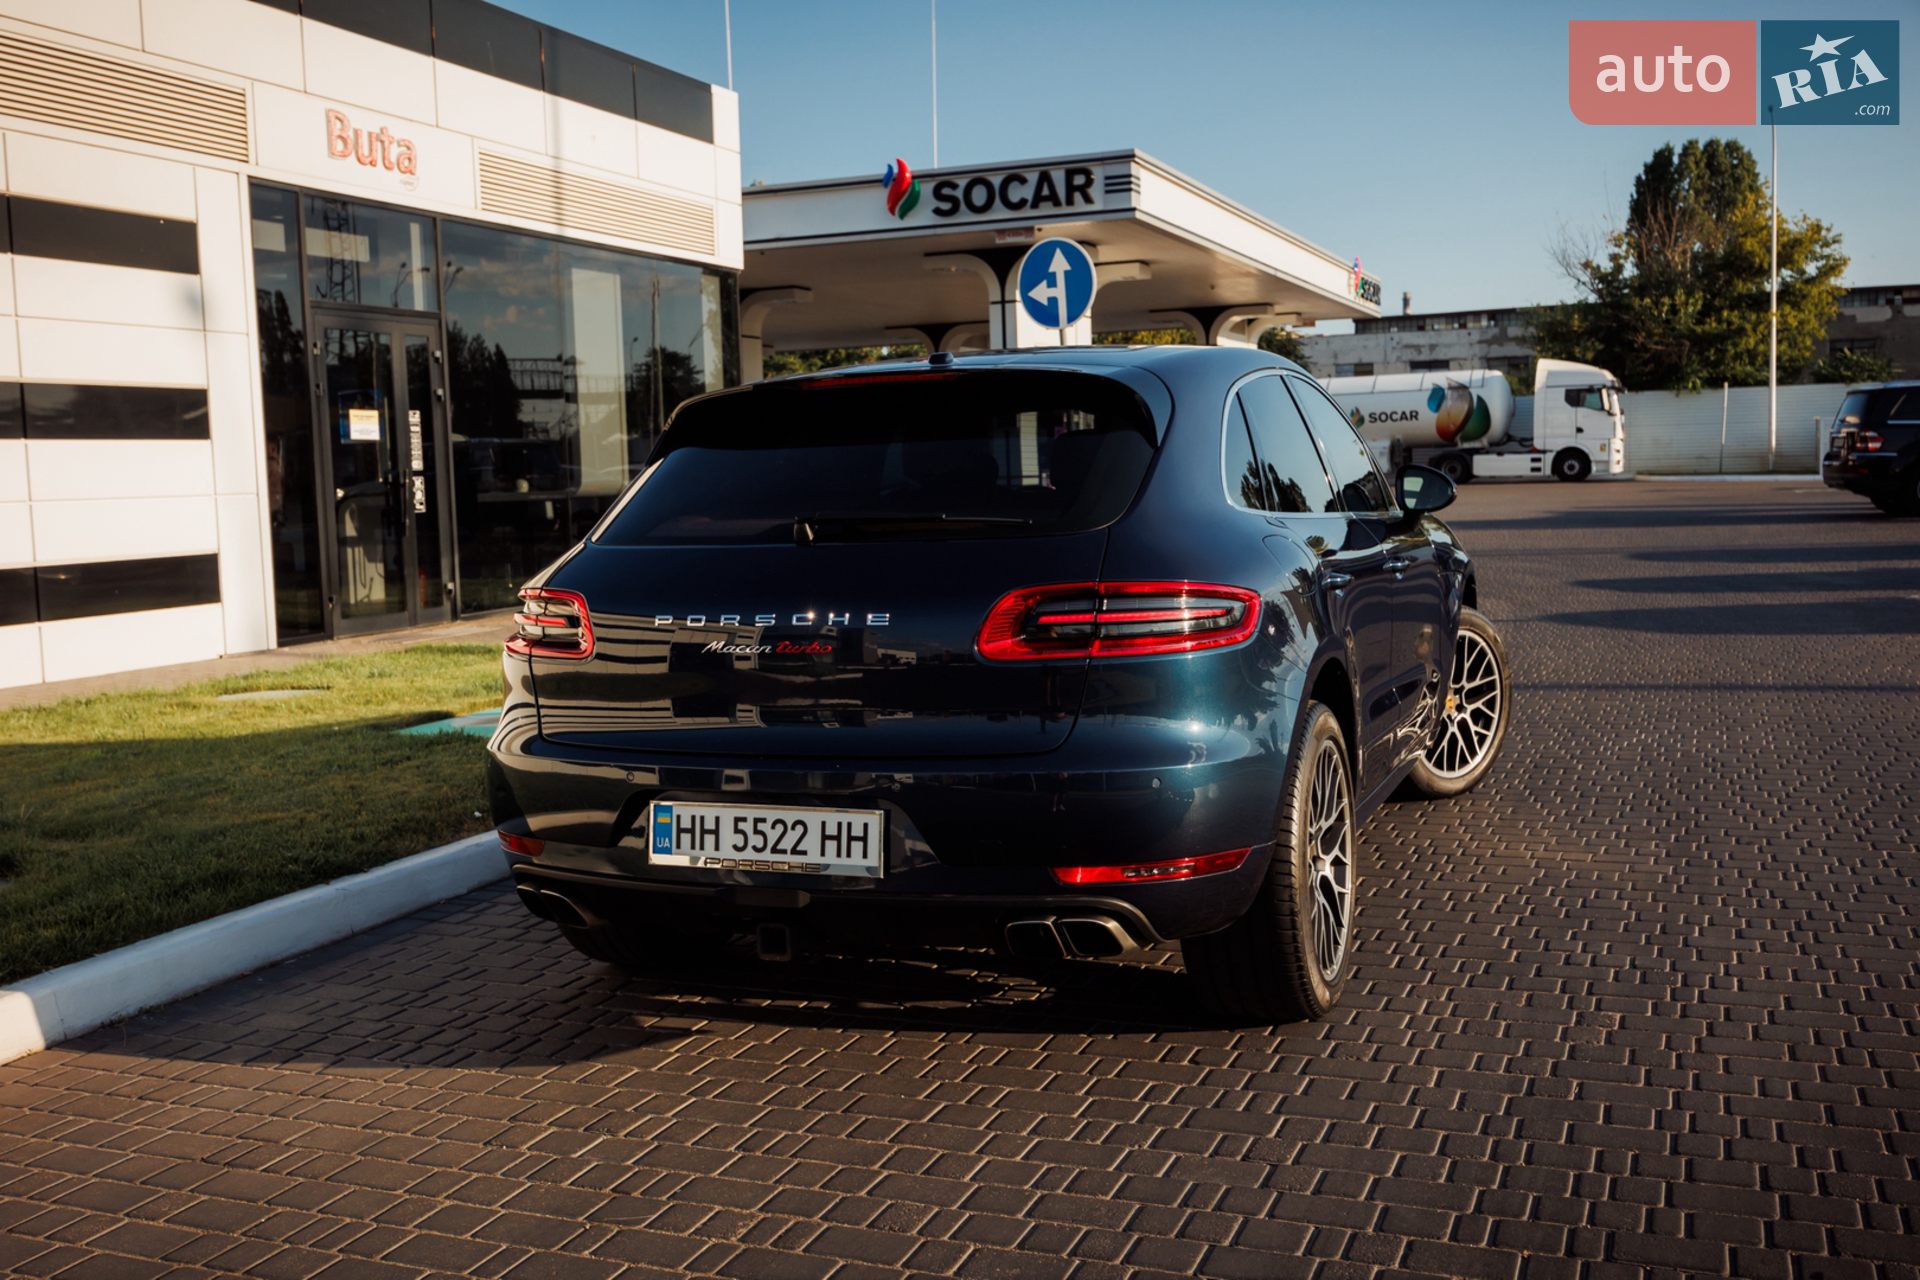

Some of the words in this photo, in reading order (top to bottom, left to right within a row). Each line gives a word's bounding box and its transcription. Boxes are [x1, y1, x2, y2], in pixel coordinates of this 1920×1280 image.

[325, 108, 417, 176] Buta
[932, 167, 1095, 218] SOCAR
[1368, 410, 1419, 424] SOCAR
[654, 614, 891, 627] PORSCHE
[701, 640, 773, 654] Macan
[656, 836, 671, 849] UA
[731, 816, 809, 857] 5522
[705, 857, 821, 872] PORSCHE
